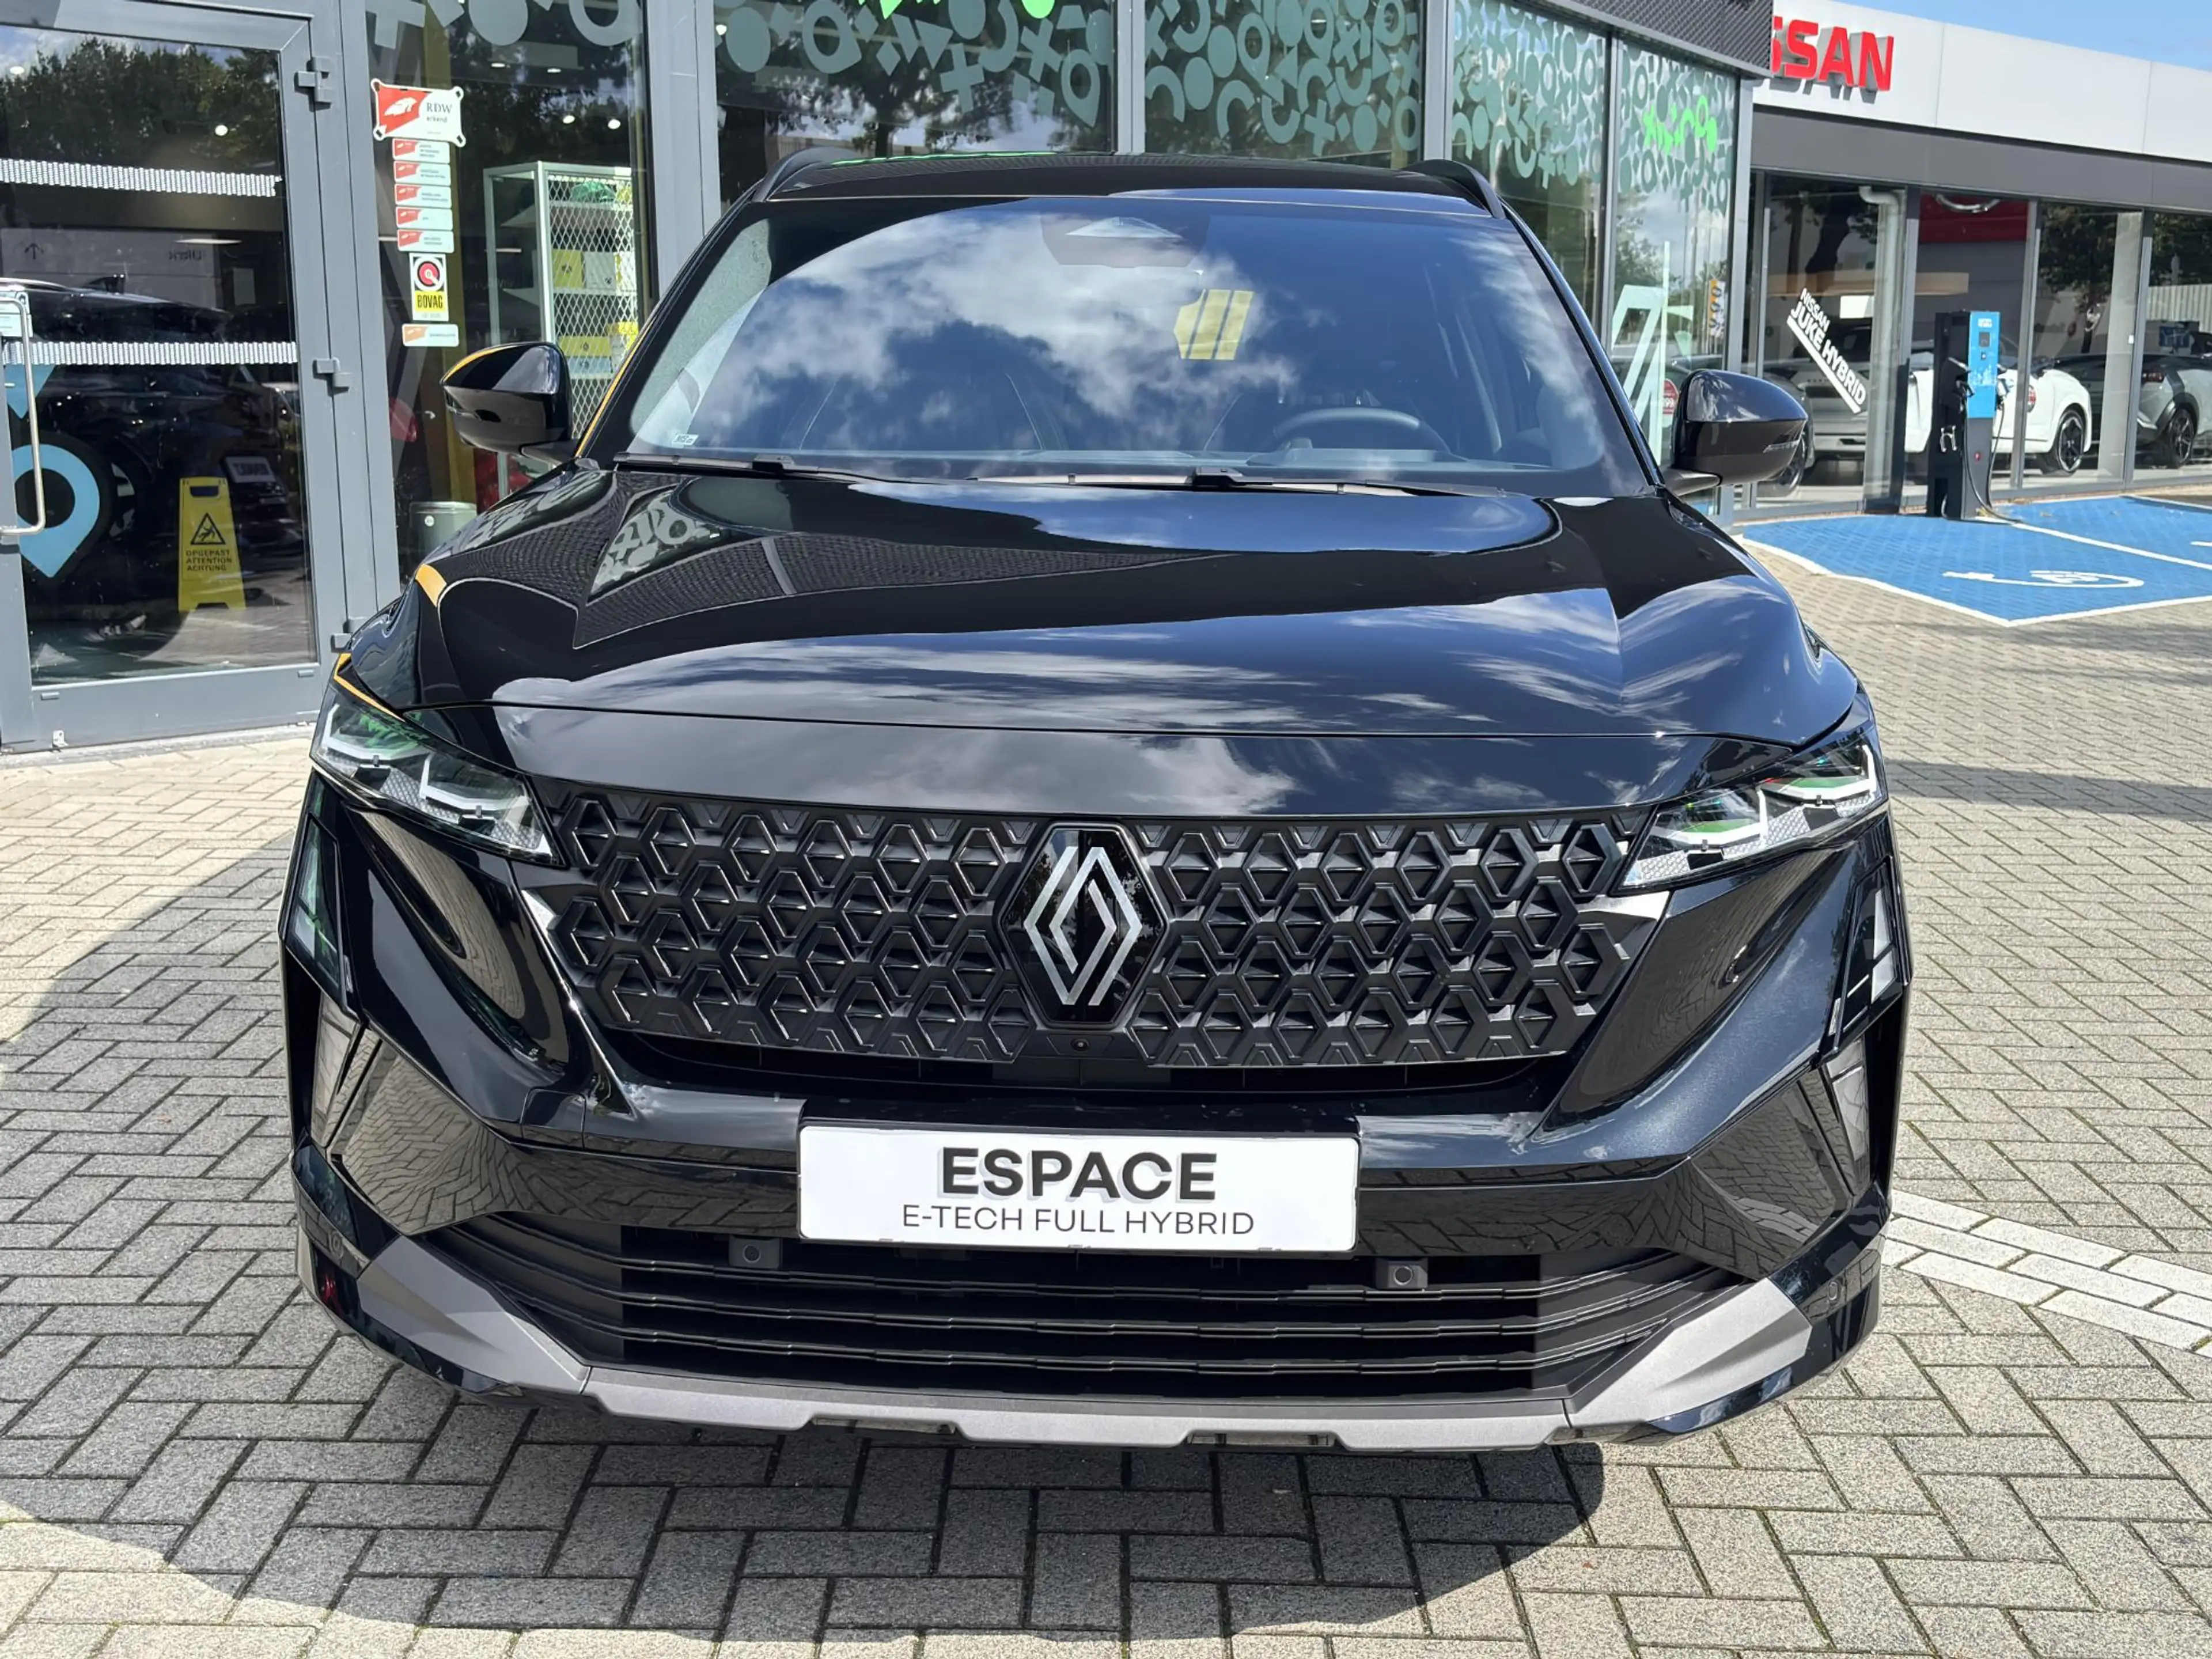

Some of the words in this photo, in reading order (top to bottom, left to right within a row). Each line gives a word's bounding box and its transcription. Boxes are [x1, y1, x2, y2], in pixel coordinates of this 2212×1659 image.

[426, 102, 453, 113] RDW
[417, 294, 444, 309] BOVAG
[1800, 288, 1831, 332] NISSAN
[1790, 301, 1825, 351] JUKE
[1821, 339, 1866, 406] HYBRID
[940, 1146, 1218, 1201] ESPACE
[903, 1205, 1022, 1231] E-TECH
[1035, 1209, 1115, 1234] FULL
[1126, 1210, 1255, 1236] HYBRID
